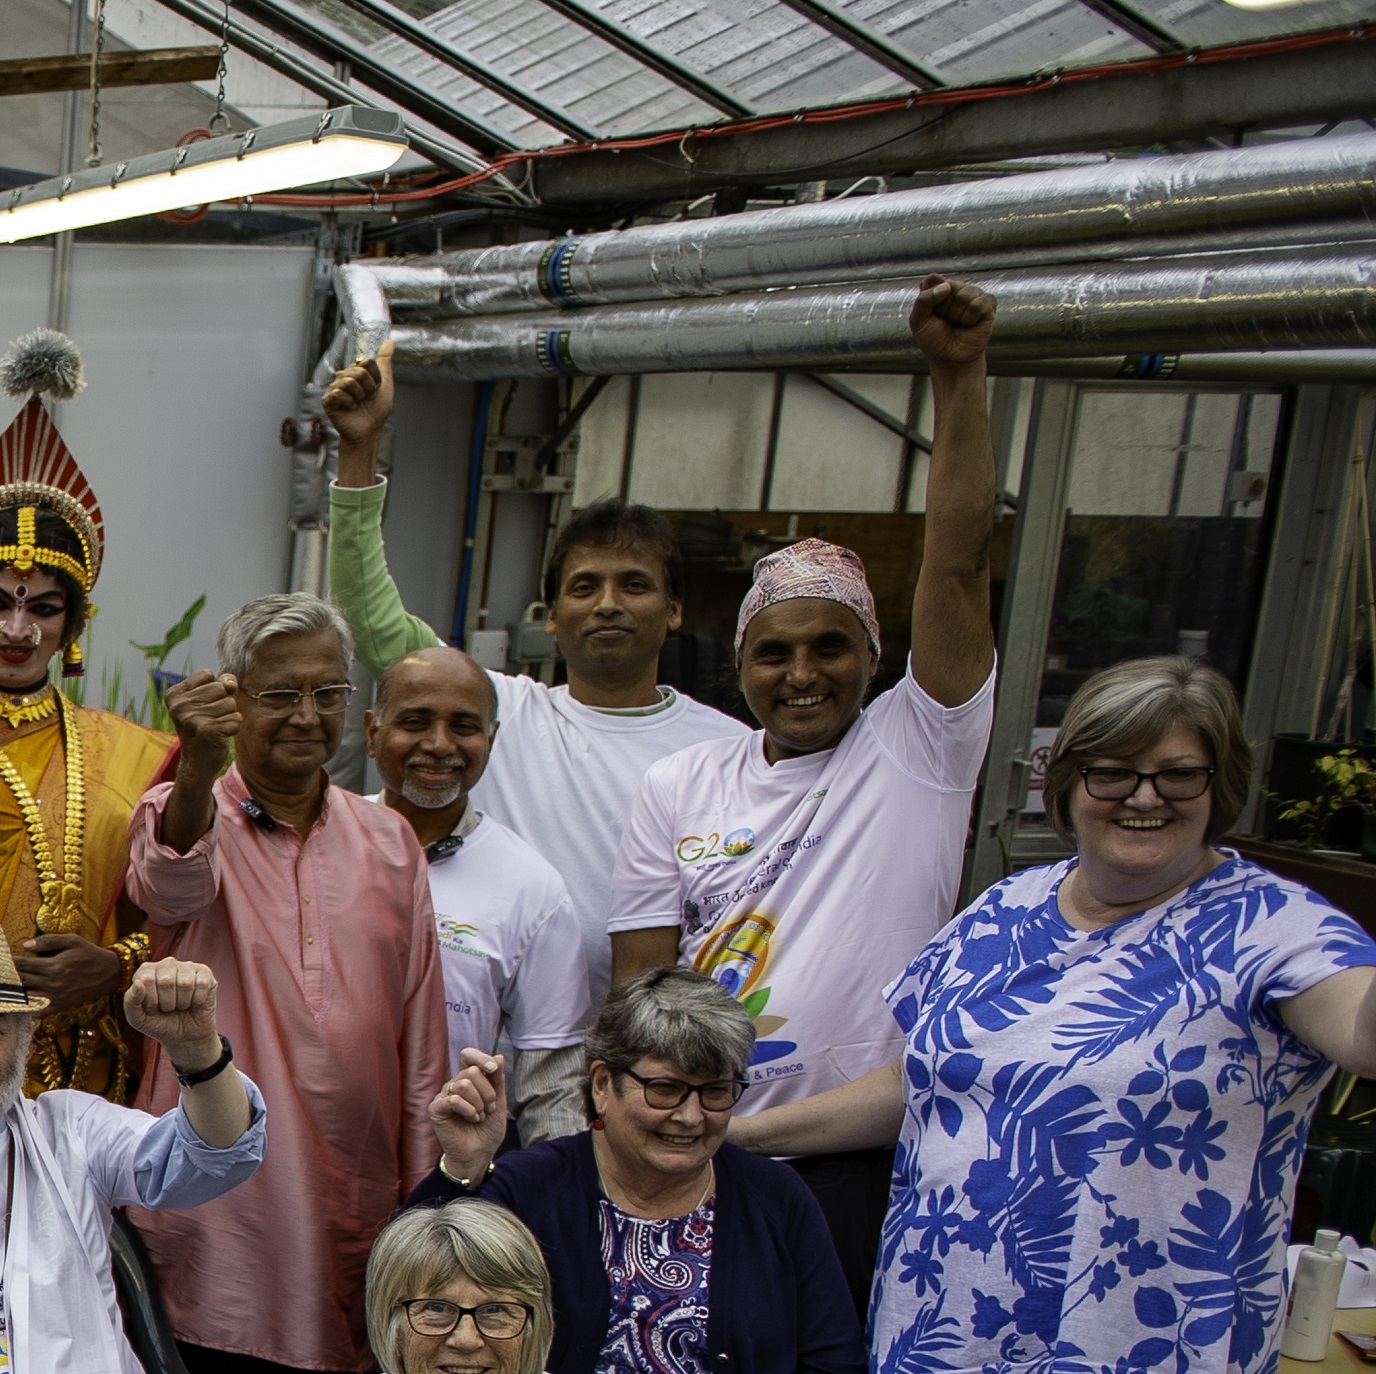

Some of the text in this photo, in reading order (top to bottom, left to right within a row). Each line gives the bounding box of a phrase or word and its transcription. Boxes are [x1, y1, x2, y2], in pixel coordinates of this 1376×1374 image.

[677, 828, 755, 862] G20
[446, 1001, 471, 1014] ndia
[754, 1062, 804, 1080] & Peace
